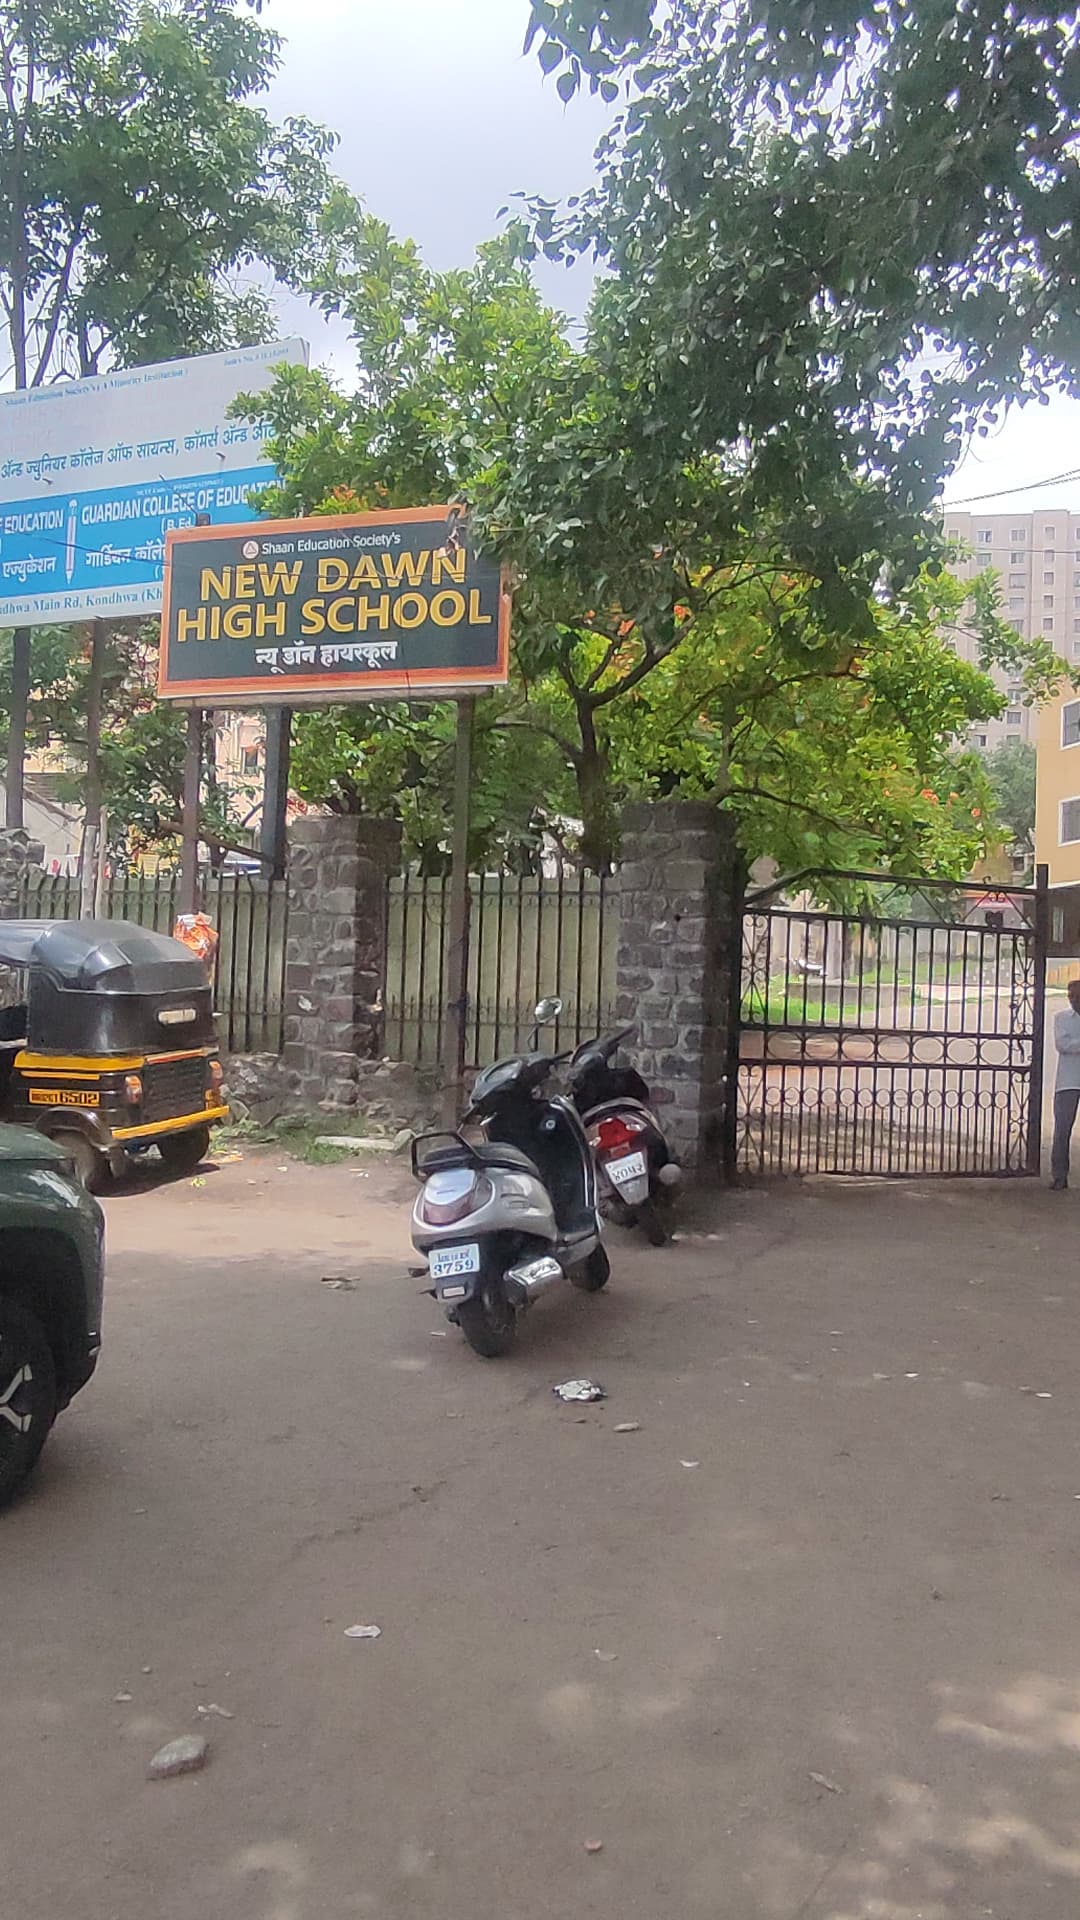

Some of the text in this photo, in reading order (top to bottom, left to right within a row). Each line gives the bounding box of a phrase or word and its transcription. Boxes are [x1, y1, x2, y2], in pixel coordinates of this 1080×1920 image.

[4, 509, 64, 534] EDUCATION
[82, 498, 140, 525] GUARDIAN
[142, 490, 195, 516] COLLEGE
[197, 489, 213, 510] OF
[262, 531, 401, 555] Shaan Education Society's
[200, 547, 466, 602] NEW DAWN
[33, 597, 60, 611] Main
[86, 590, 138, 607] Kondhwa
[176, 588, 492, 643] HIGH SCHOOL
[255, 647, 285, 674] न्यू
[282, 640, 316, 665] डॉन
[433, 1259, 474, 1277] 3759
